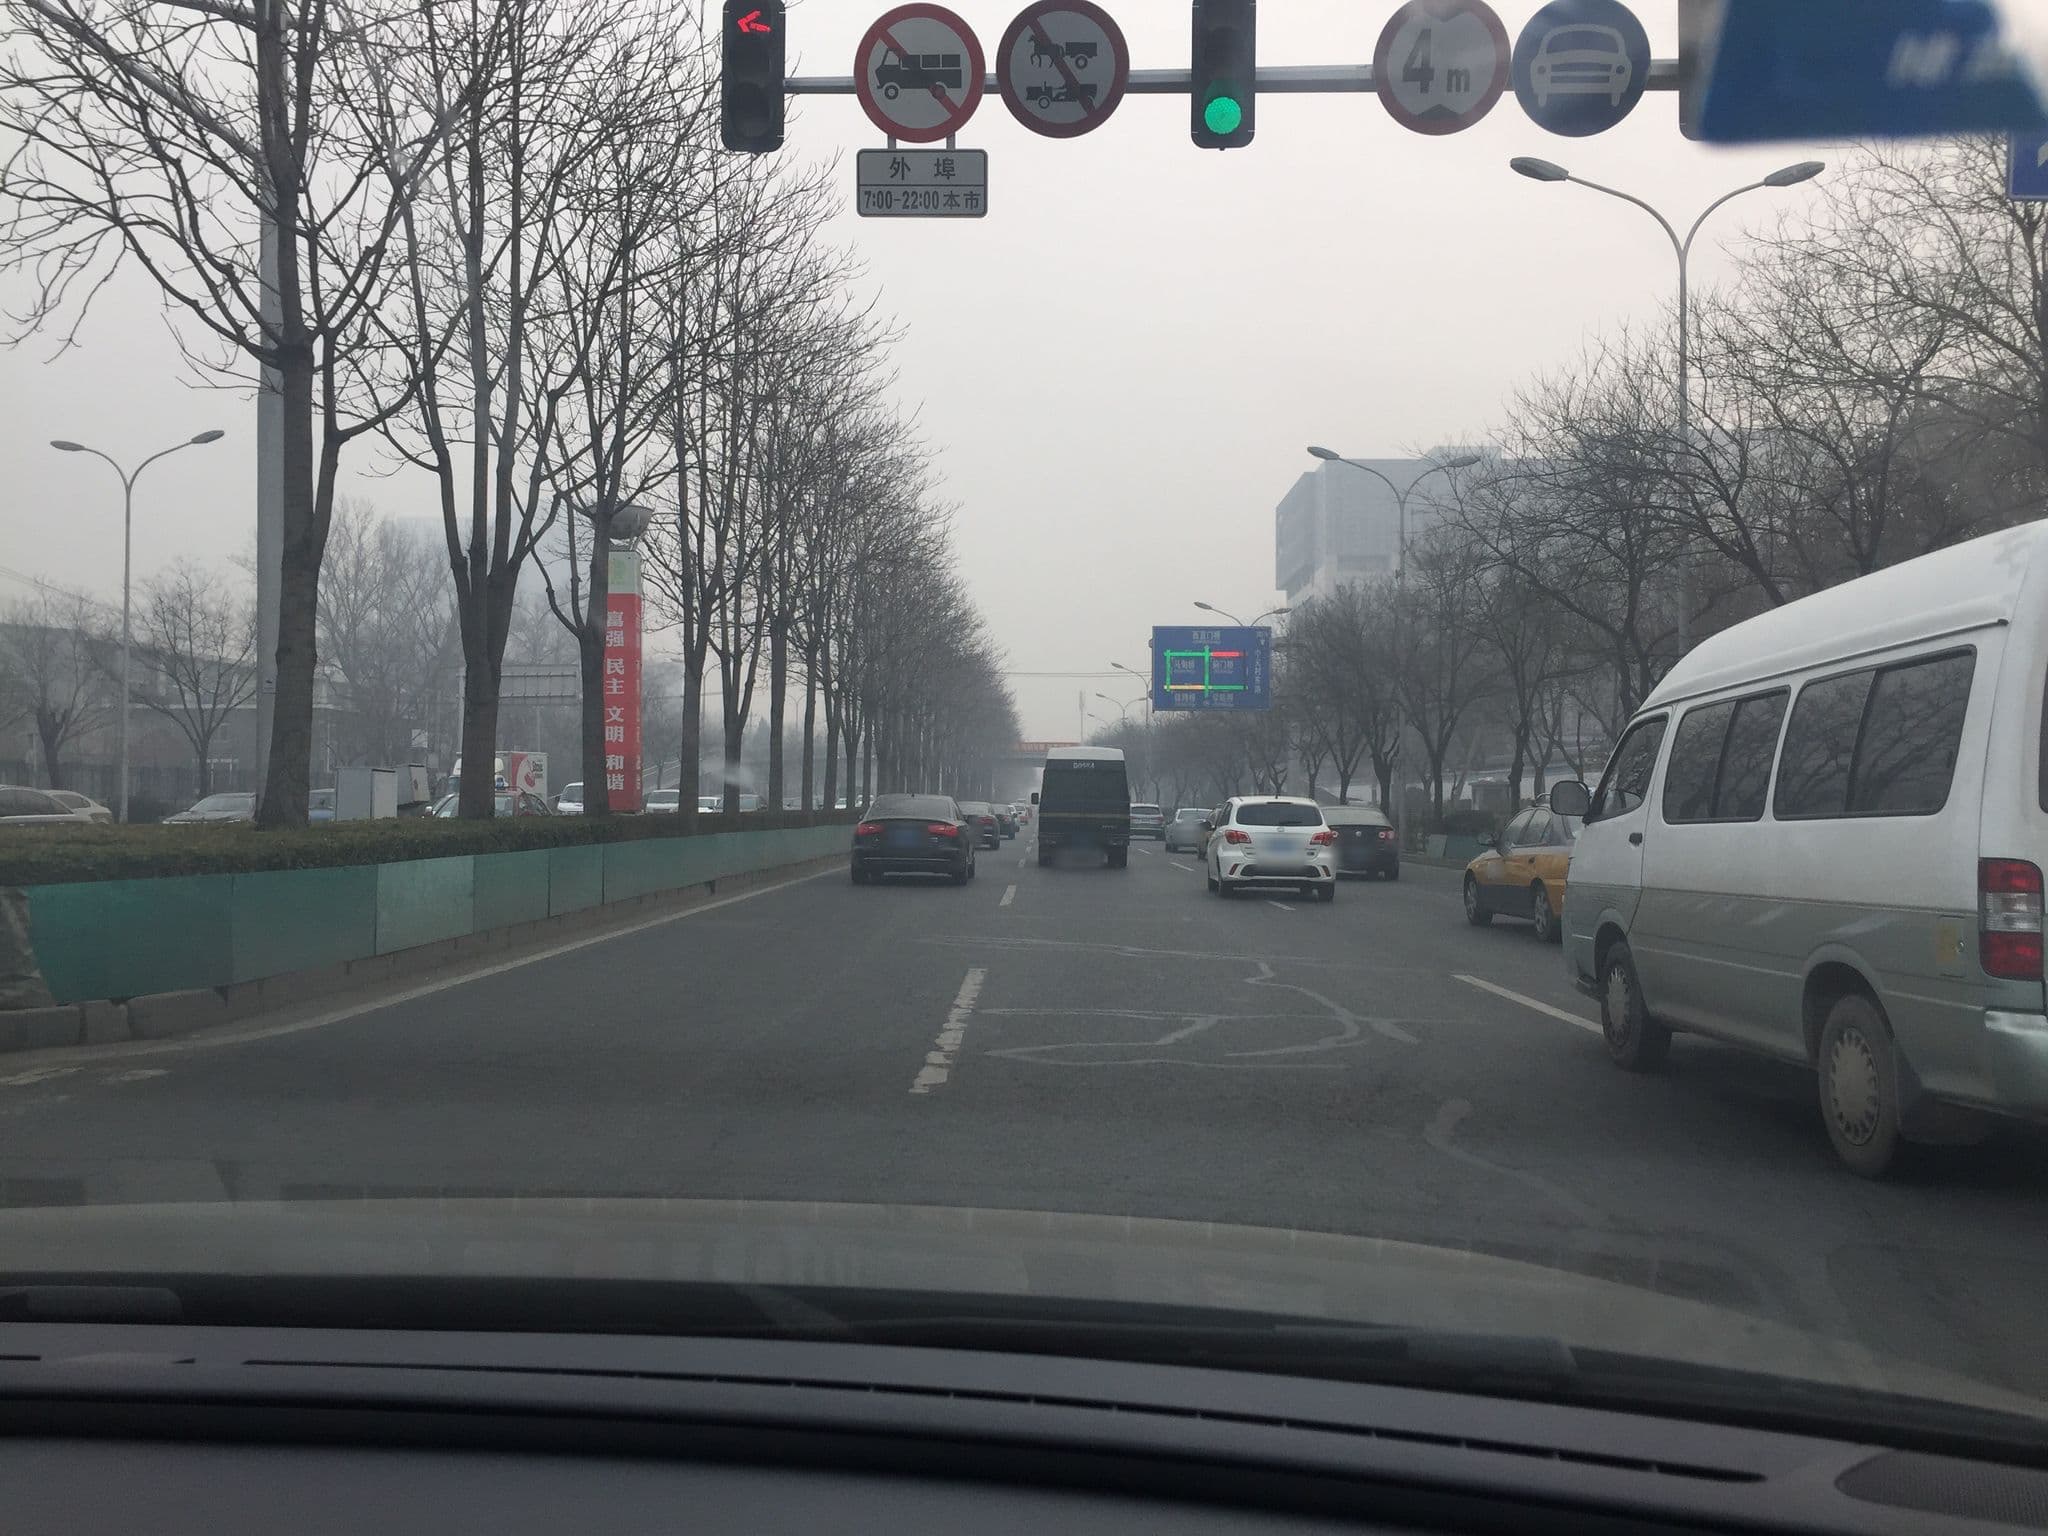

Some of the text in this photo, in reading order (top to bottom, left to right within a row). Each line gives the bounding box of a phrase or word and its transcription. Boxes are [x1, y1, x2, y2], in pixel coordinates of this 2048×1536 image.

[605, 611, 625, 790] 富强 民主 文明 和谐
